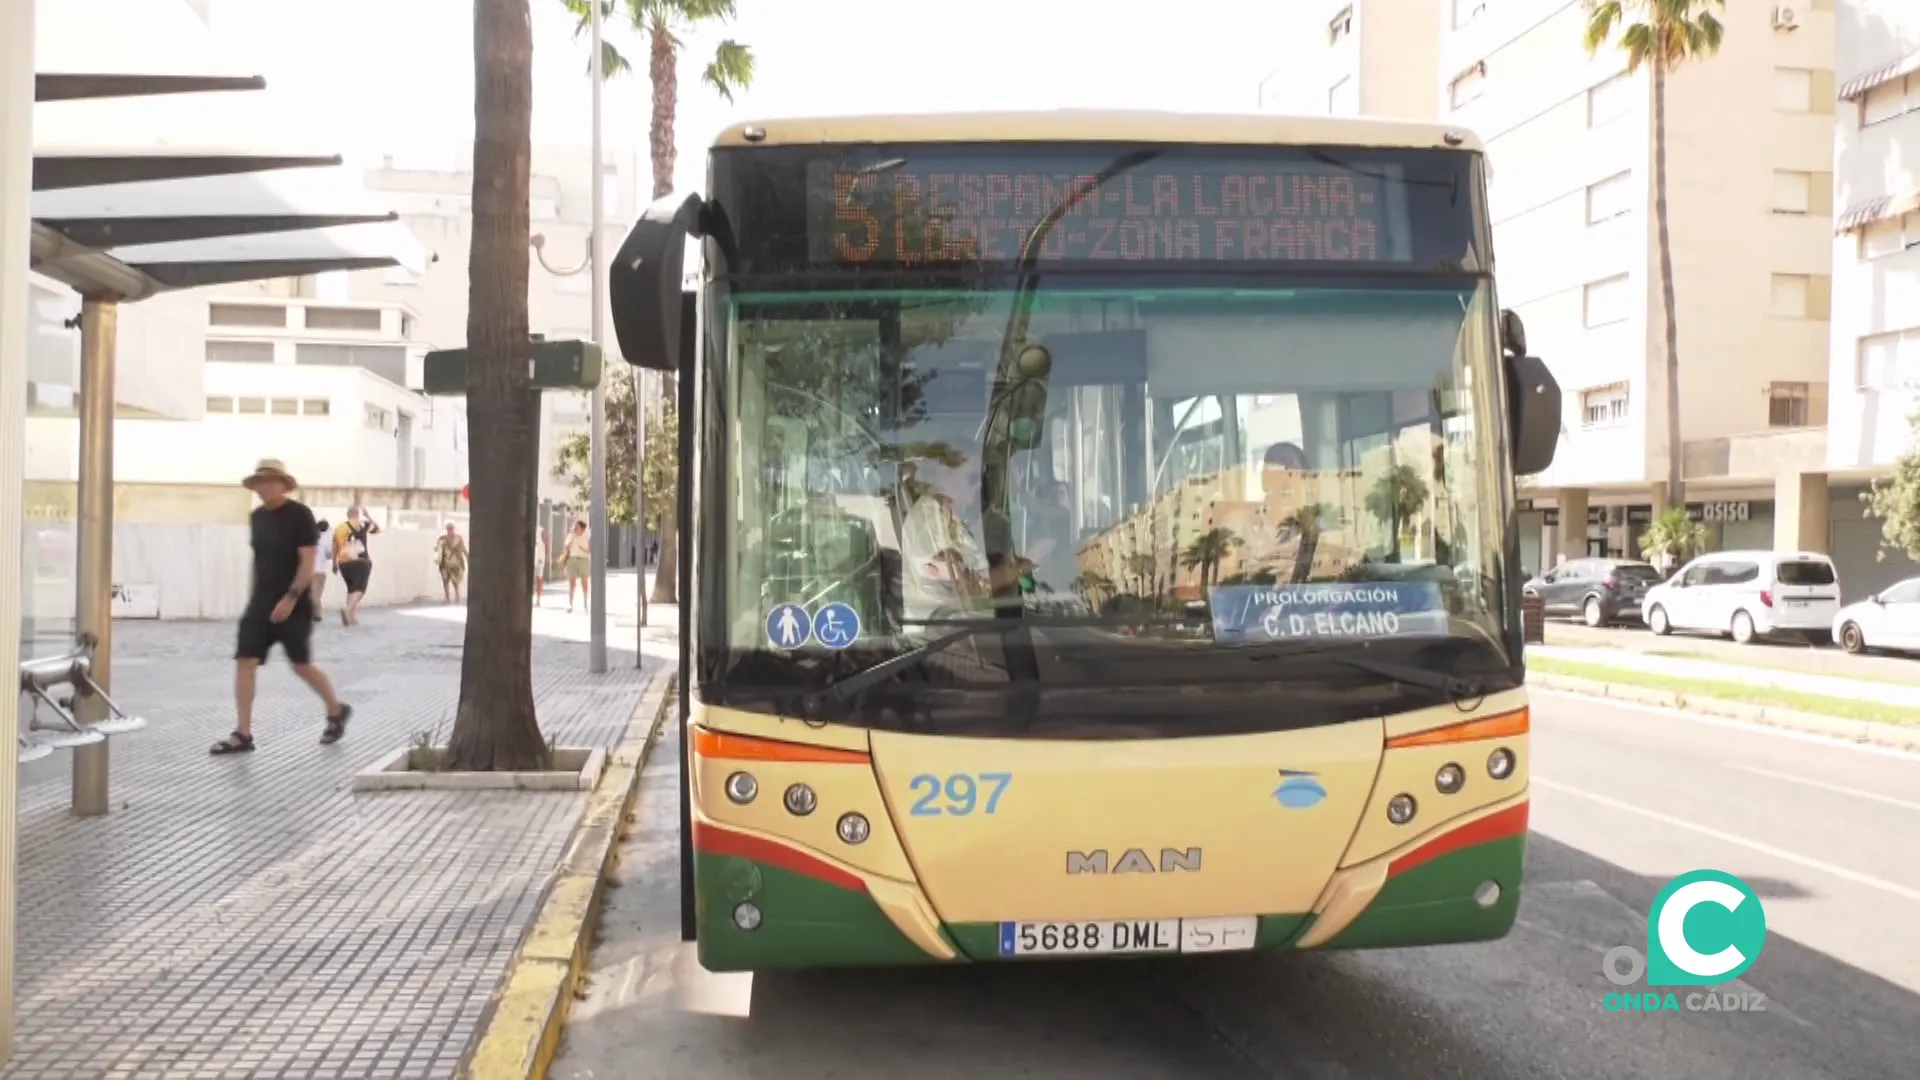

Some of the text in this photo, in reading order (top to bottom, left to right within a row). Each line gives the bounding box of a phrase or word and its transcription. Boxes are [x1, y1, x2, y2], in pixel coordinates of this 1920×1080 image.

[833, 171, 881, 261] 5
[1215, 219, 1377, 260] FRANCA
[1254, 588, 1399, 606] PROLONGACIÓN
[1264, 611, 1399, 637] C. D. ELCANO
[909, 773, 1013, 816] 297
[1065, 847, 1203, 875] MAN
[1020, 922, 1170, 950] 5688 DML
